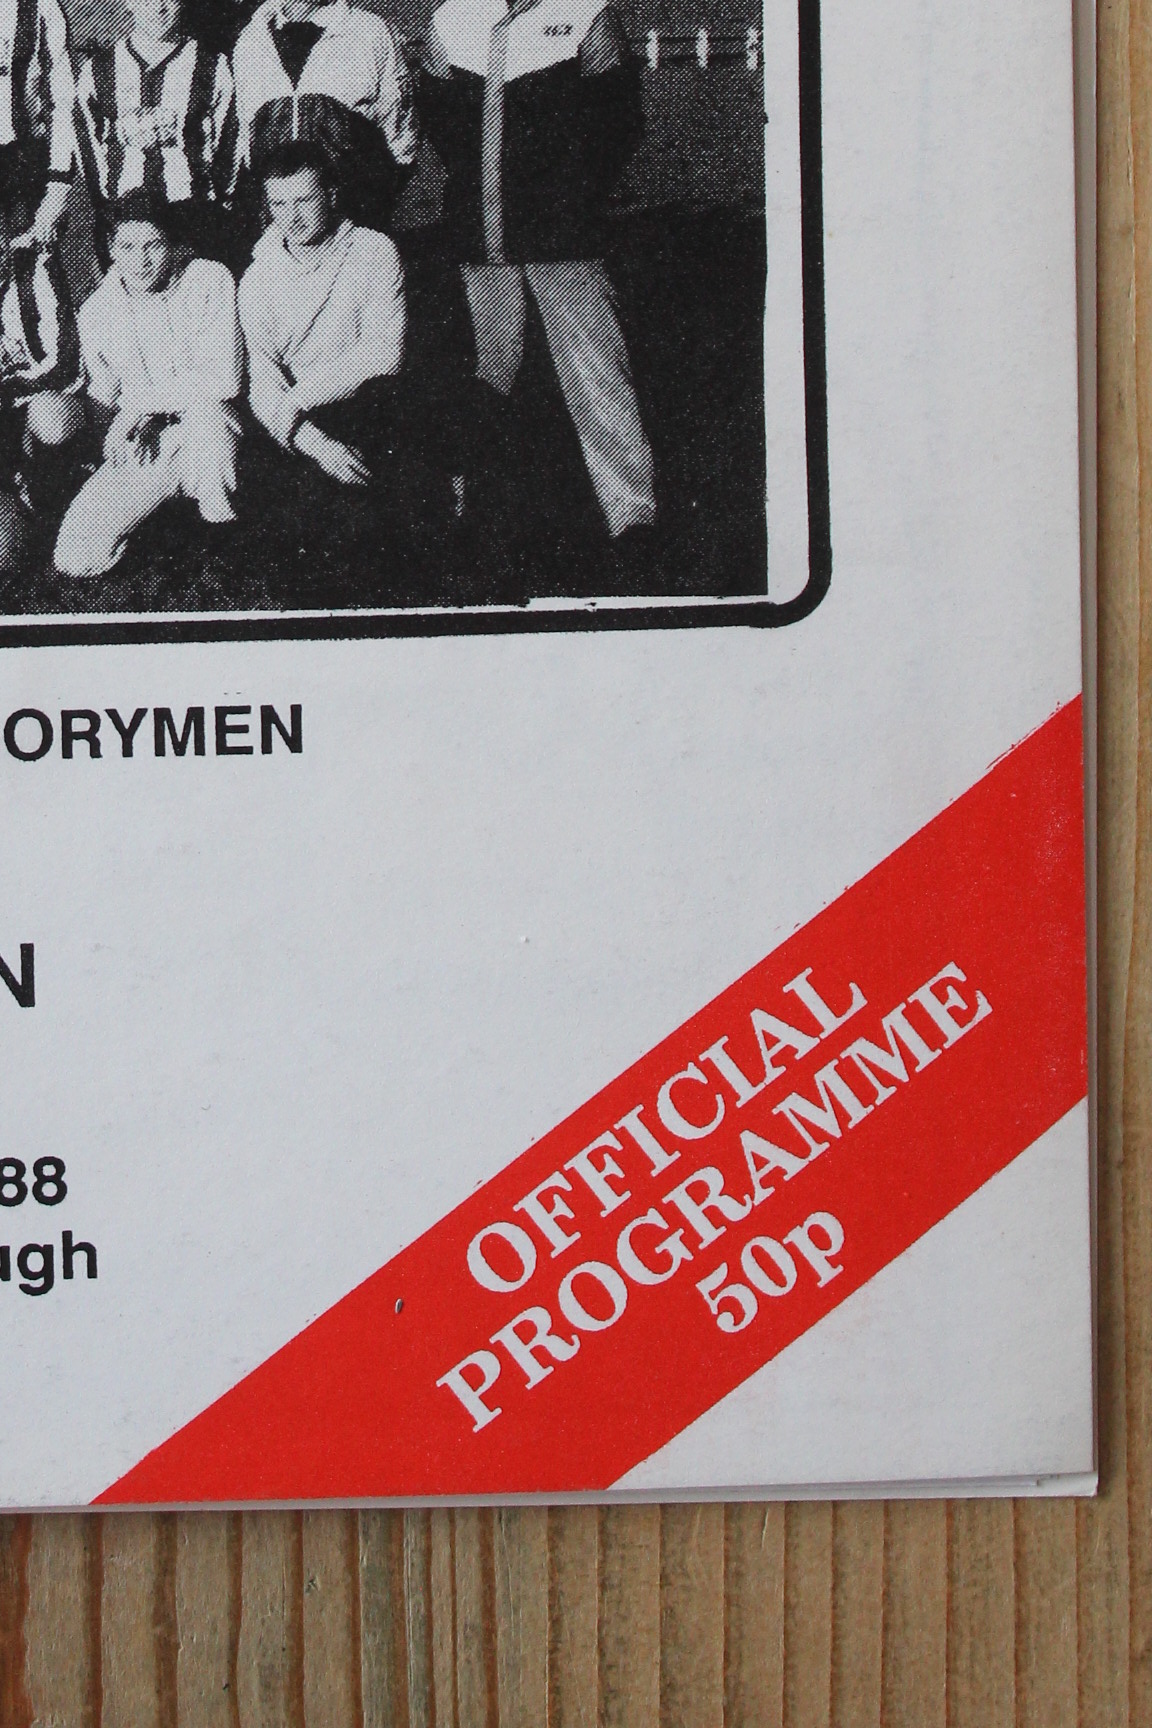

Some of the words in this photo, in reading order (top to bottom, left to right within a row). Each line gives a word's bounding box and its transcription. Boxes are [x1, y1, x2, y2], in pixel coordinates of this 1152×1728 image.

[435, 961, 993, 1433] PROGRAMME
[466, 966, 868, 1293] OFFICIAL
[695, 1211, 845, 1333] 50p
